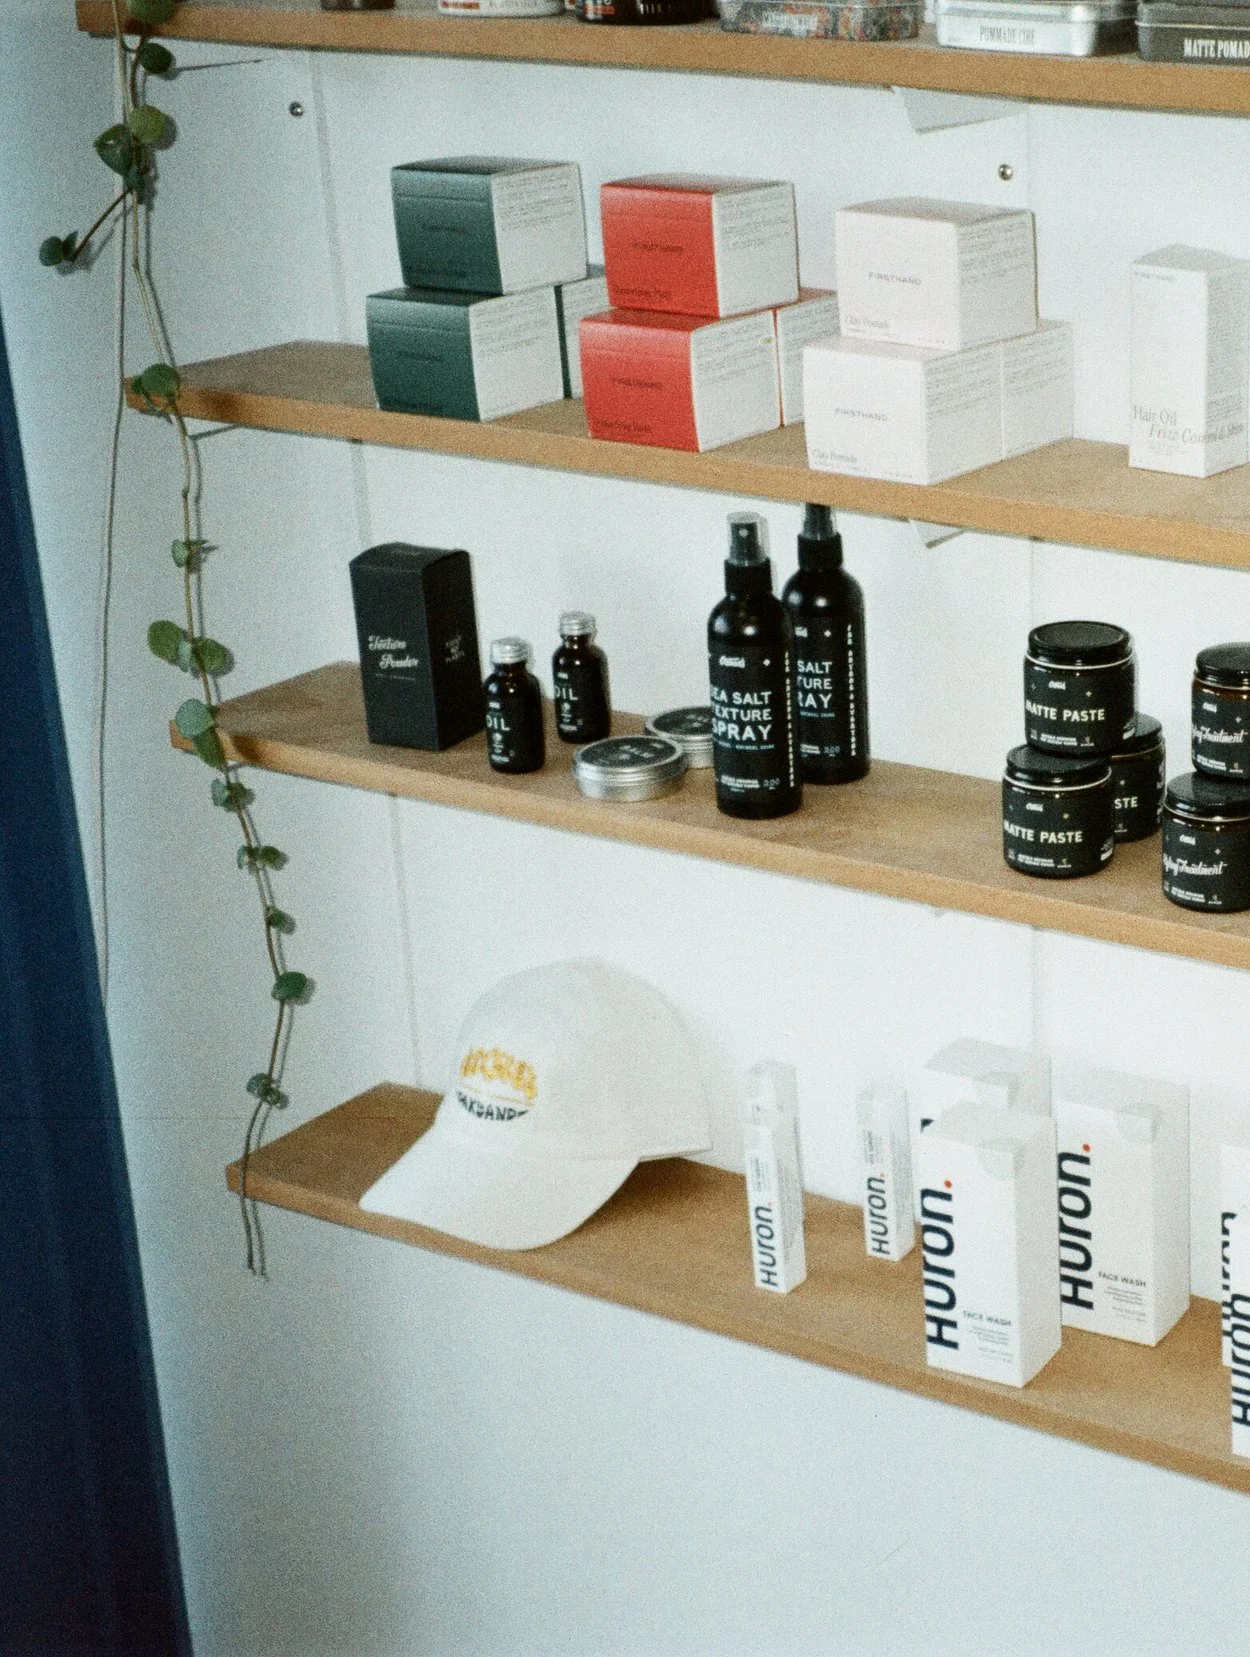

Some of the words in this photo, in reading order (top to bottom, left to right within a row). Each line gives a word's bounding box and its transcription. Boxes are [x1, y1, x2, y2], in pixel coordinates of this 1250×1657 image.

[979, 25, 1017, 45] POMMADE
[1183, 38, 1217, 59] MATTE
[868, 271, 921, 286] FIRSTHAND
[834, 406, 888, 422] FIRSTHAND
[1132, 404, 1157, 422] Hair
[1159, 409, 1178, 426] Oil
[379, 653, 420, 670] Powder
[797, 660, 833, 675] SALT
[732, 690, 773, 706] SALT
[1025, 699, 1058, 721] MATTE
[1062, 707, 1106, 722] PASTE
[485, 713, 511, 732] OIL
[712, 716, 773, 741] SPRAY
[1114, 796, 1139, 810] STE
[1003, 819, 1036, 842] MATTE
[1039, 830, 1084, 845] PASTE
[1098, 1270, 1119, 1282] FACE
[1120, 1275, 1147, 1288] WASH
[962, 1309, 983, 1321] FACE
[985, 1314, 1012, 1327] WASH
